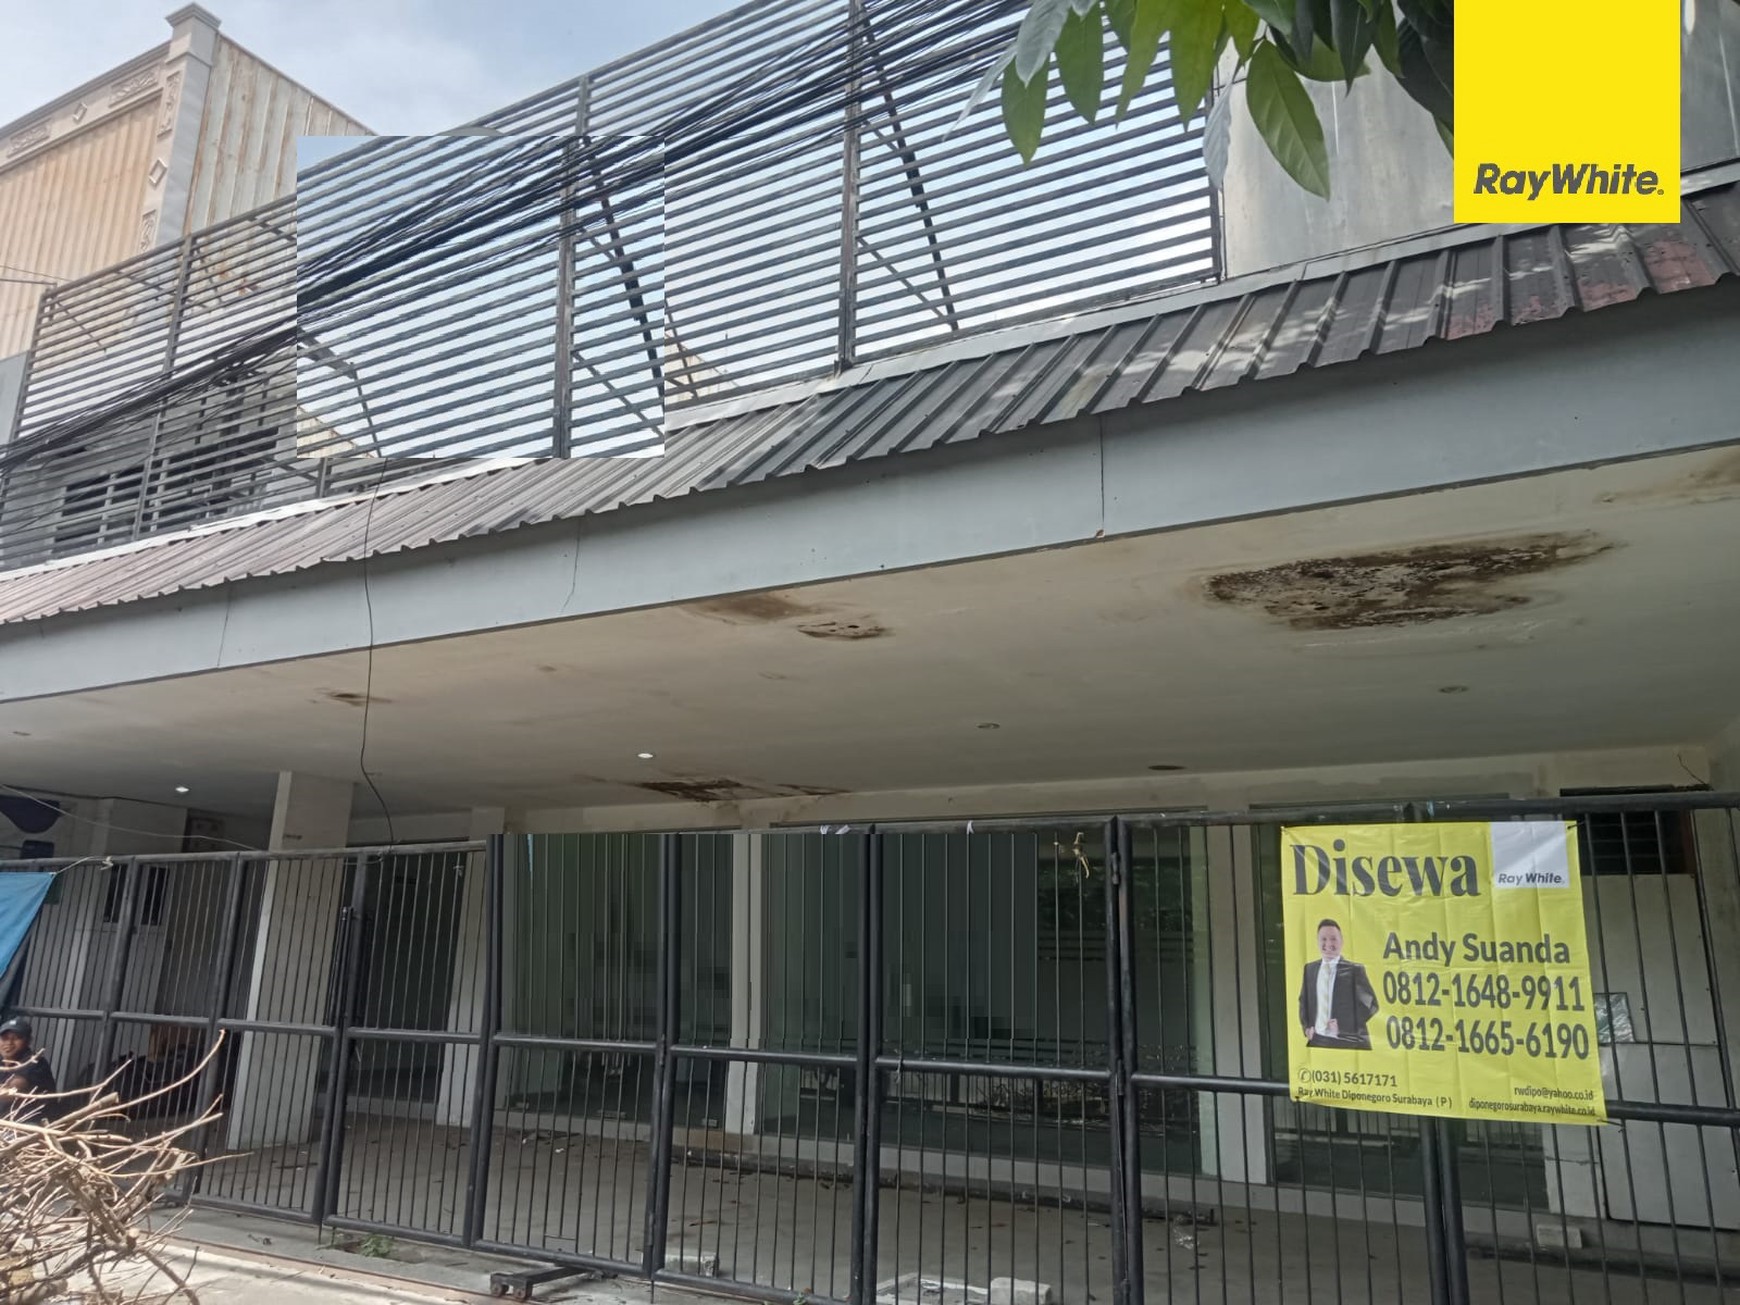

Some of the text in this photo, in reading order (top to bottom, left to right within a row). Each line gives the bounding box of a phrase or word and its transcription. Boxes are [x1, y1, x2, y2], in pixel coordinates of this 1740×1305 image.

[1290, 839, 1481, 897] Disewa
[1498, 872, 1562, 886] Ray White
[1383, 932, 1570, 967] Andy Suanda
[1383, 970, 1585, 1012] 0812-1648-9911
[1386, 1015, 1590, 1061] 0812-1665-6190
[1312, 1070, 1397, 1087] (031) 5617171
[1298, 1087, 1313, 1098] Ray
[1314, 1088, 1340, 1099] White
[1341, 1090, 1391, 1104] Diponegoro
[1393, 1093, 1433, 1108] Surabaya
[1514, 1085, 1594, 1101] rwdipo@yahoo.co.id
